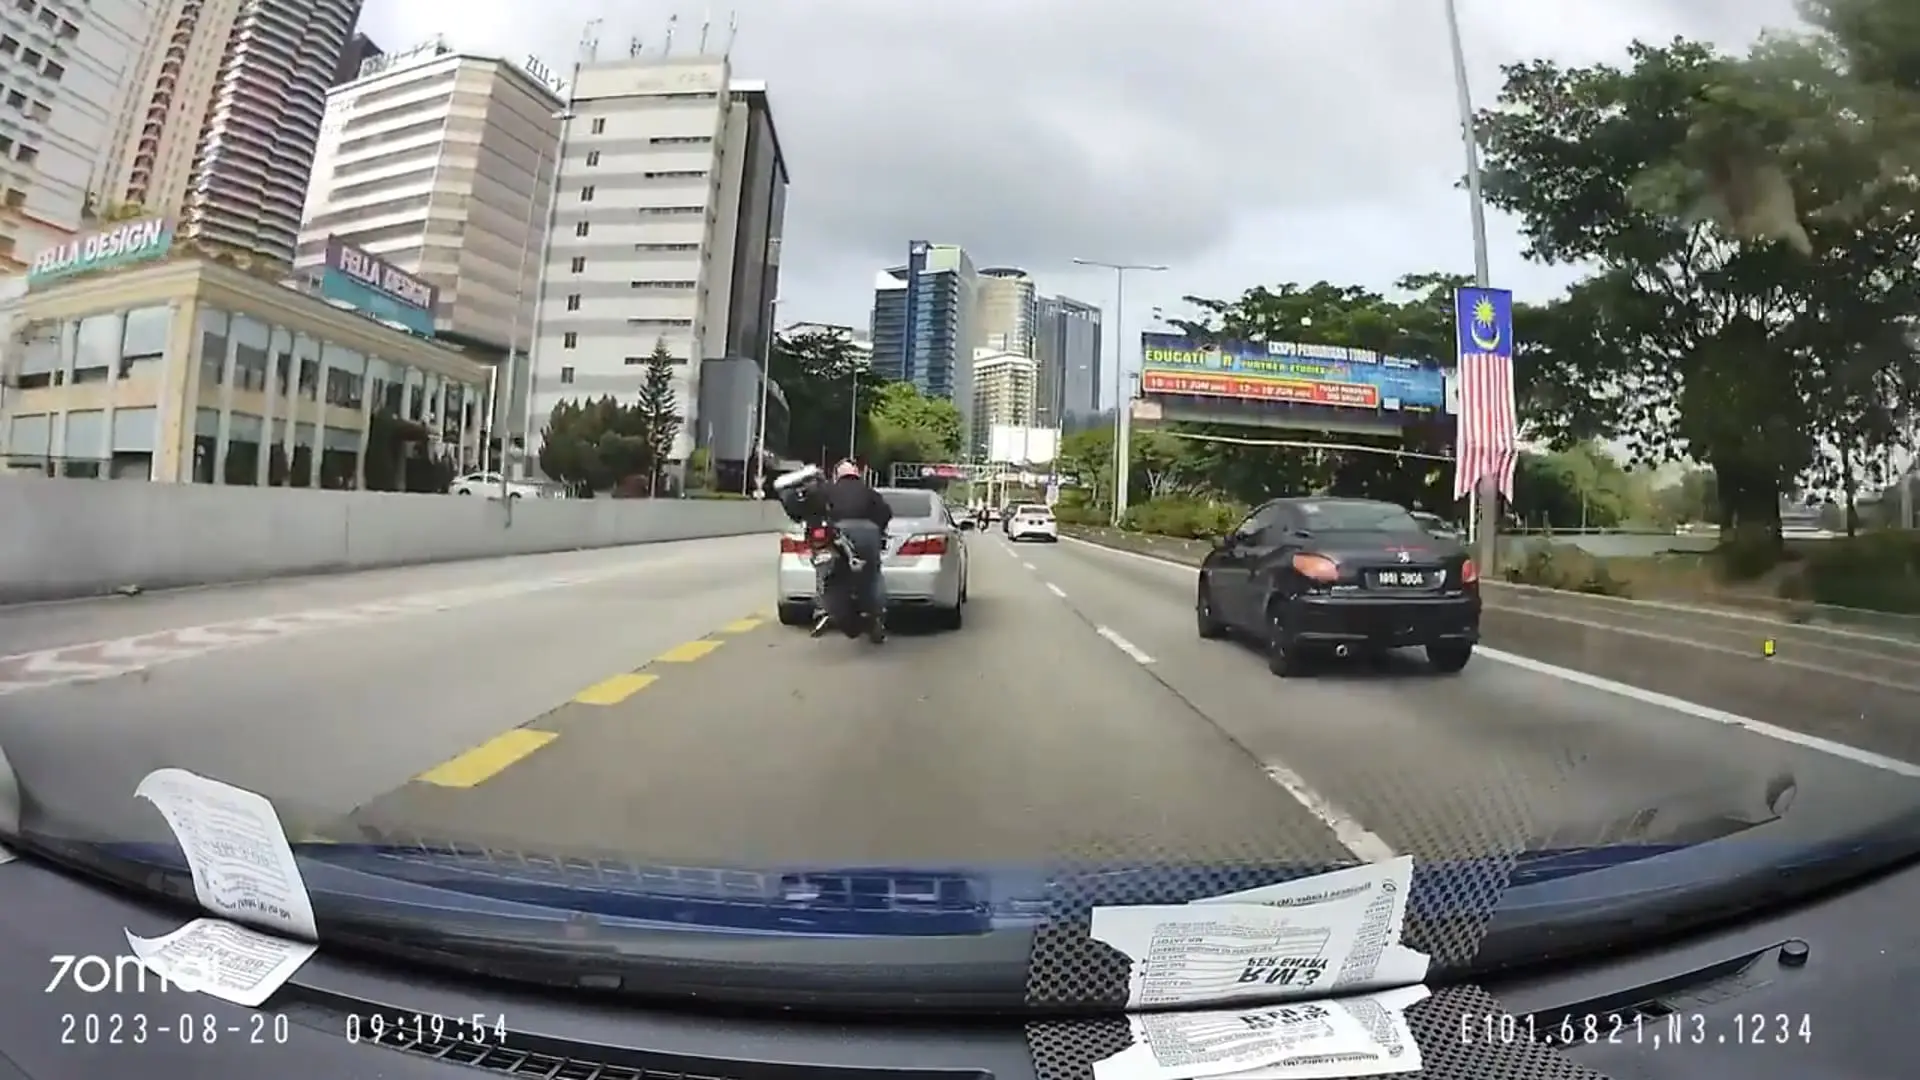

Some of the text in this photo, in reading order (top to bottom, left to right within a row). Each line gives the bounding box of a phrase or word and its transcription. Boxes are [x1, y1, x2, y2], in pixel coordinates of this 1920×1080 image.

[32, 218, 163, 277] FELLA DESIGN
[340, 246, 431, 309] FELLA DESIGN
[1145, 350, 1233, 368] EDUCATIN
